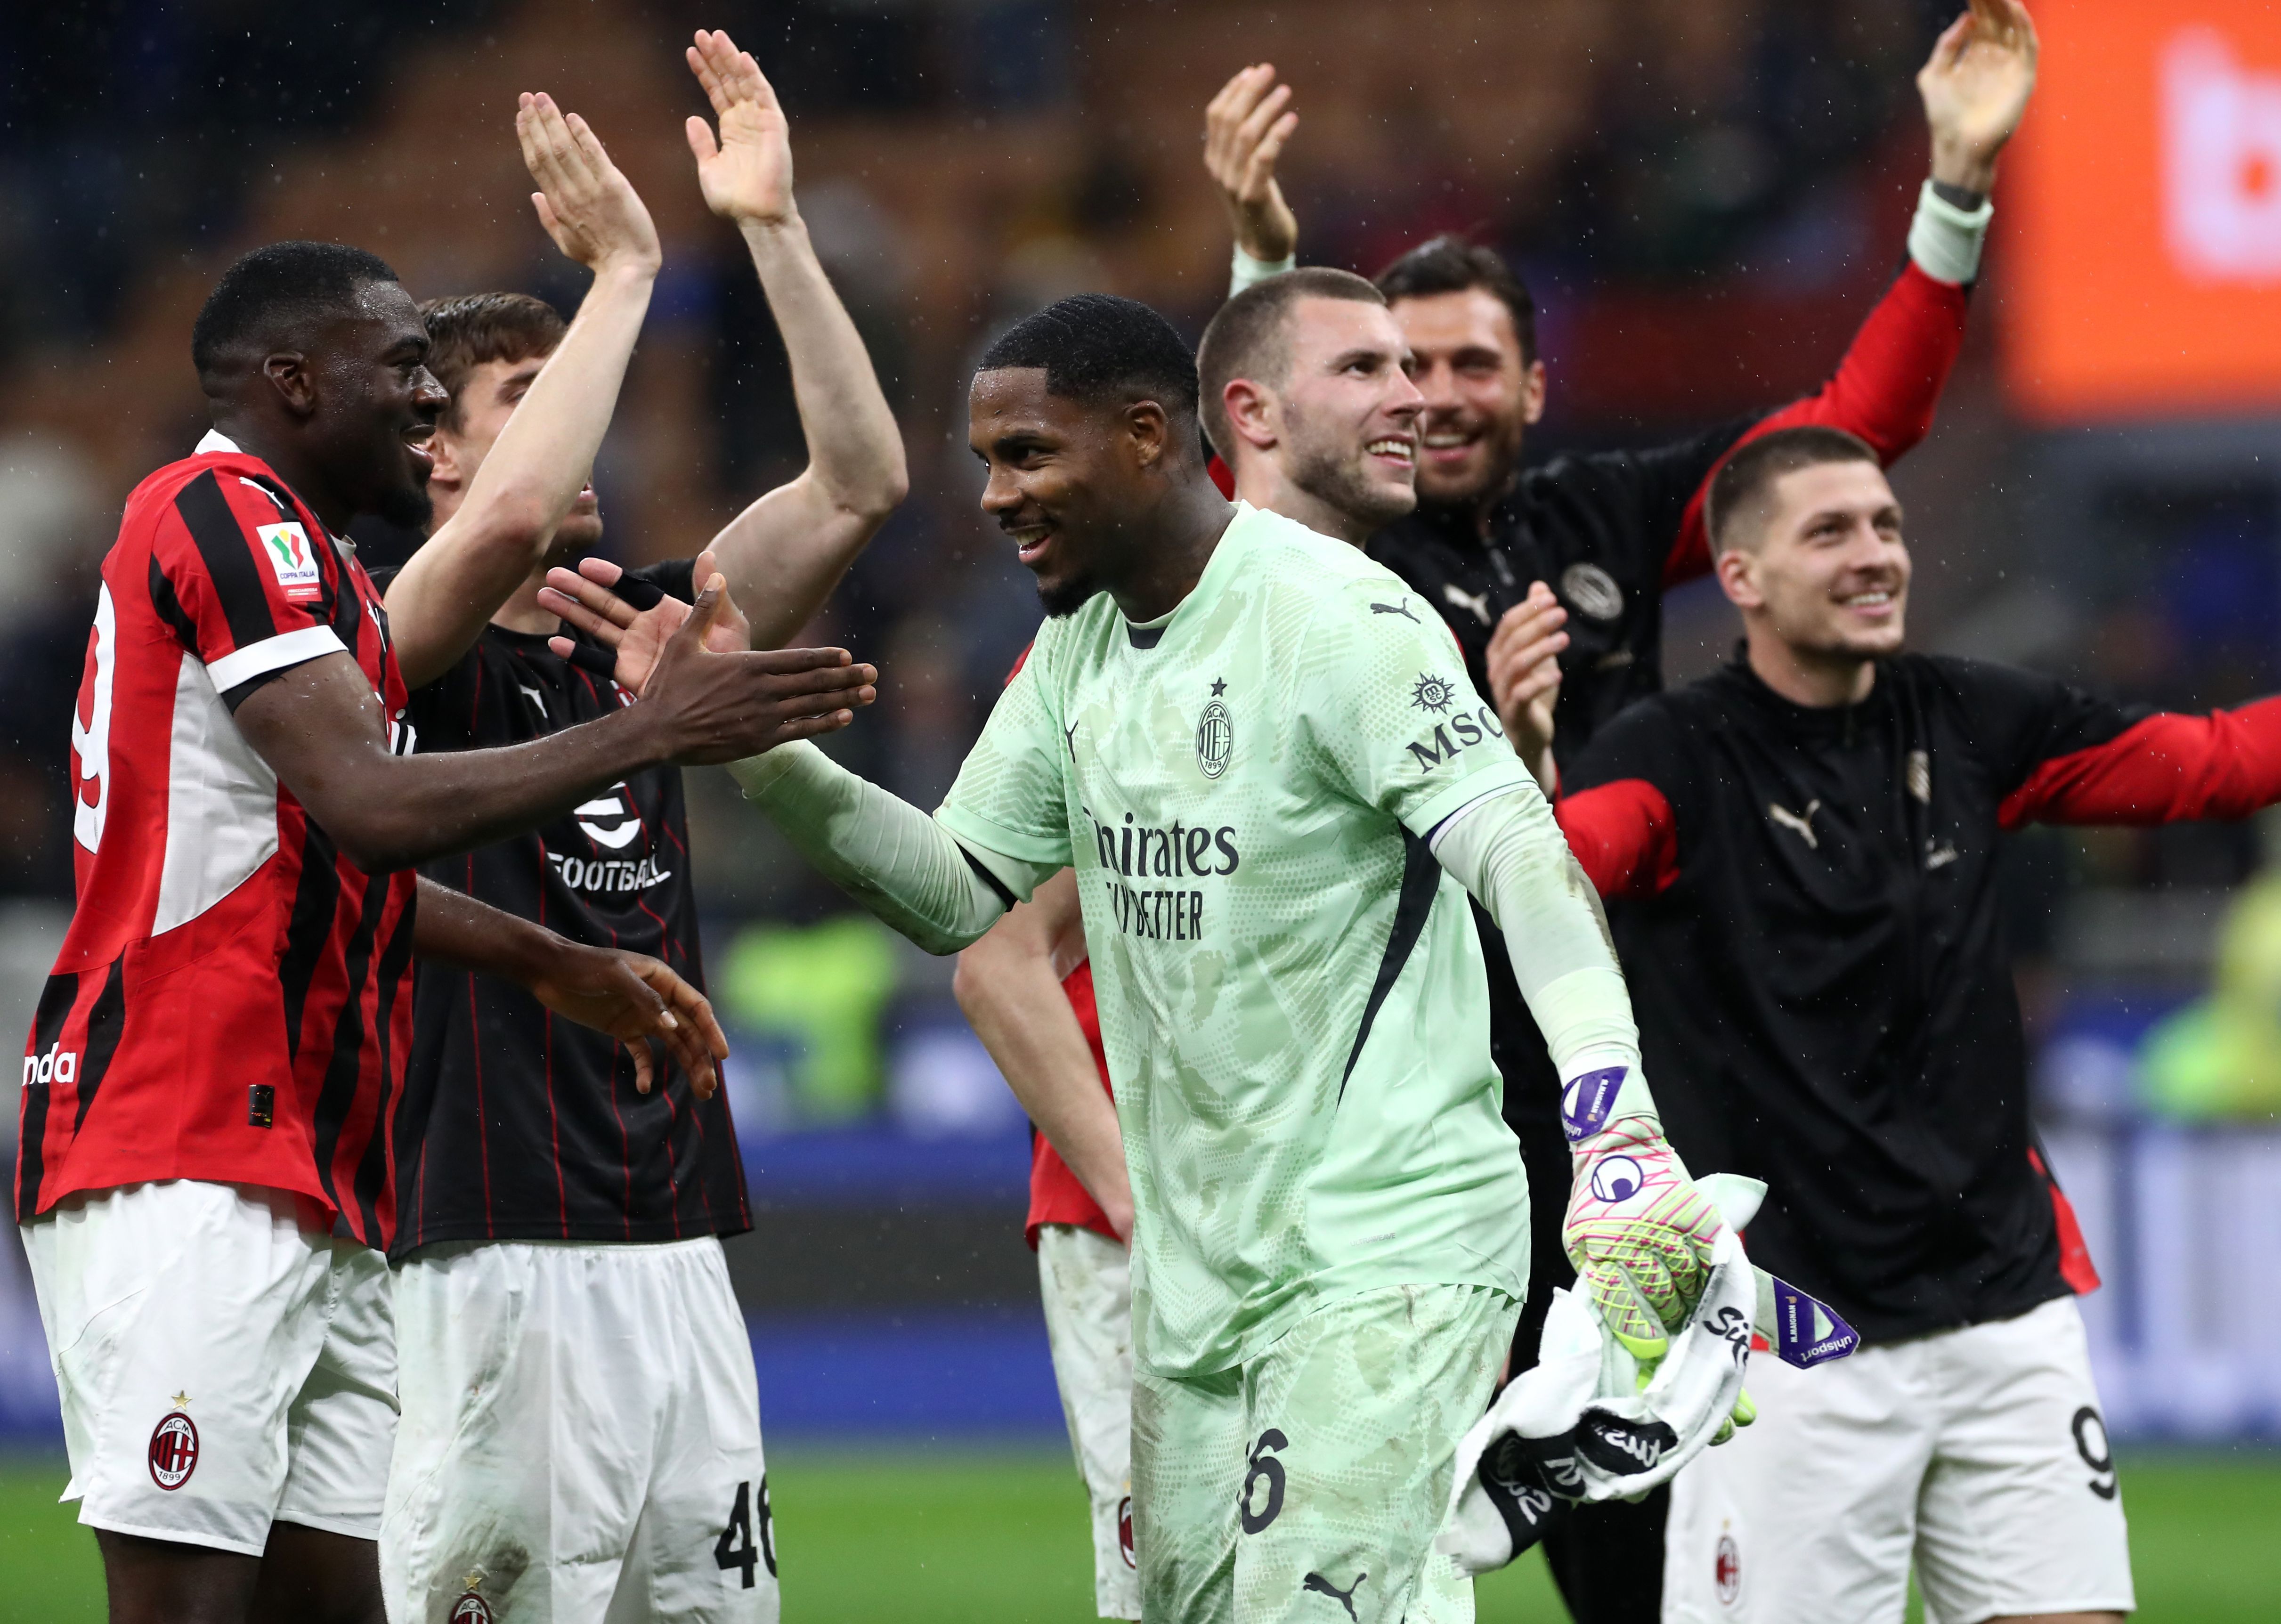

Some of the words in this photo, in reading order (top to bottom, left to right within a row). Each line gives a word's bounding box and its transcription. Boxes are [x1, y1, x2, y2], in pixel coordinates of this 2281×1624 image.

[1206, 708, 1226, 722] ACM
[1405, 706, 1503, 774] MSC
[1205, 761, 1222, 769] 1899
[1082, 806, 1239, 877] mirates
[22, 1041, 76, 1086] nda
[1591, 1079, 1609, 1113] M.MAIGNAN
[1788, 1305, 1798, 1342] M.MAIGNAN
[1801, 1335, 1852, 1362] uhlsport
[164, 1420, 189, 1435] ACM
[159, 1471, 180, 1480] 1899
